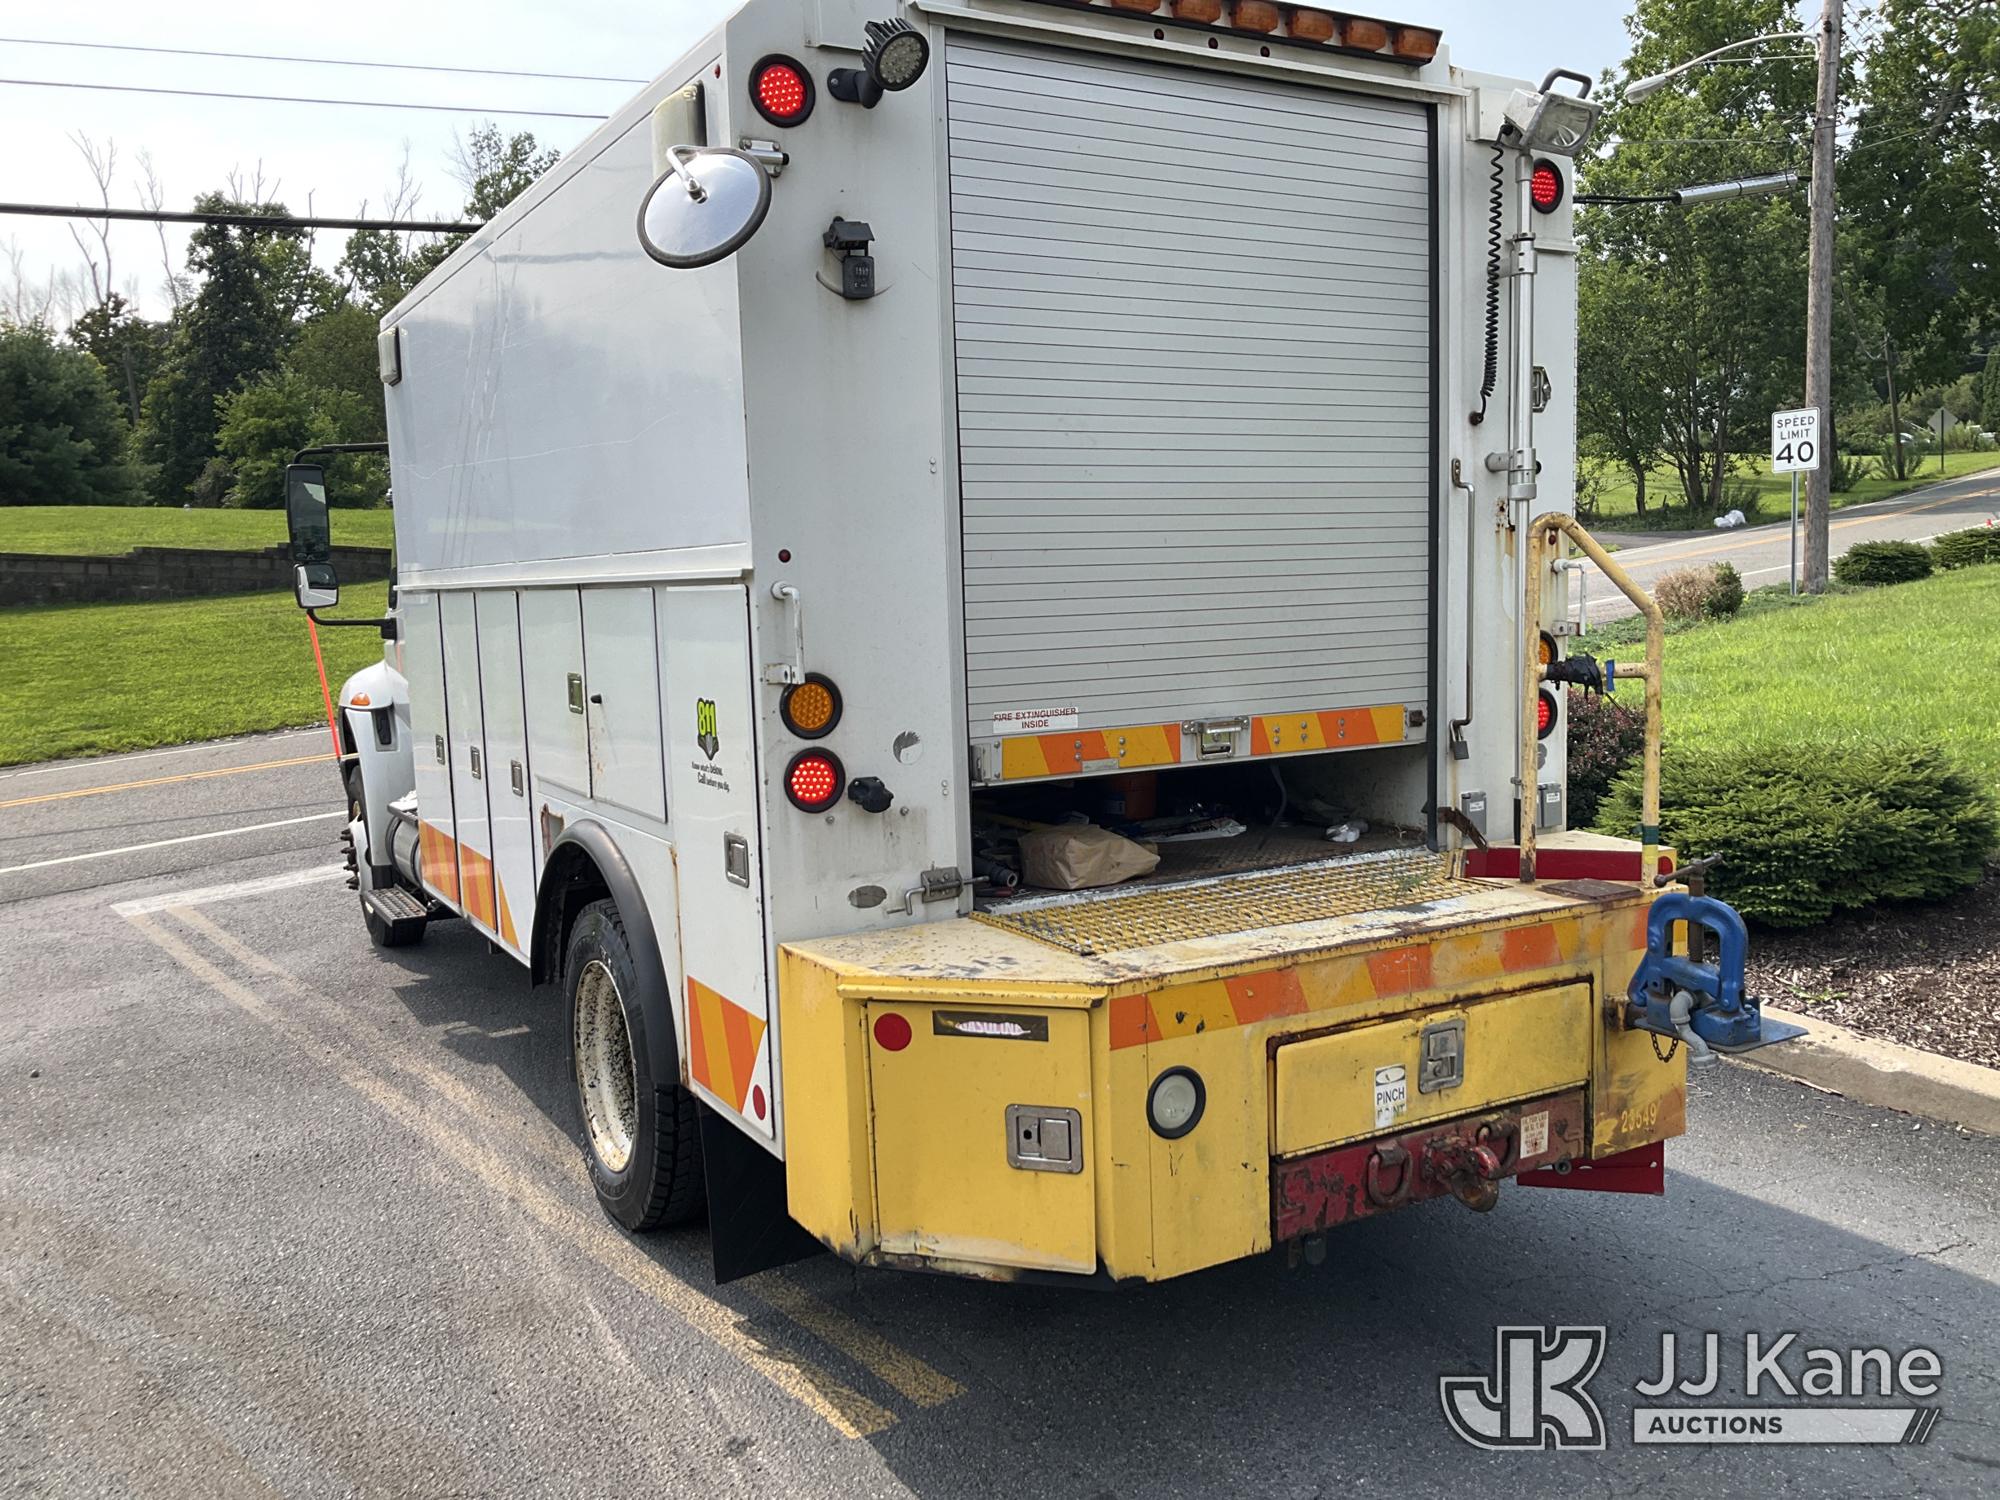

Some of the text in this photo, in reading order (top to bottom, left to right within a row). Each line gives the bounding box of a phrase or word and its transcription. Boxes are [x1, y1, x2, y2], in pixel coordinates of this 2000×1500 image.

[1777, 416, 1815, 429] SPEED
[1780, 429, 1811, 440] LIMIT
[1776, 441, 1814, 464] 40
[698, 698, 717, 737] 811
[994, 707, 1077, 722] FIRE EXTINGUISHER
[1021, 719, 1049, 729] INSIDE
[1376, 1087, 1405, 1105] PINCH
[1377, 1104, 1405, 1120] PNT
